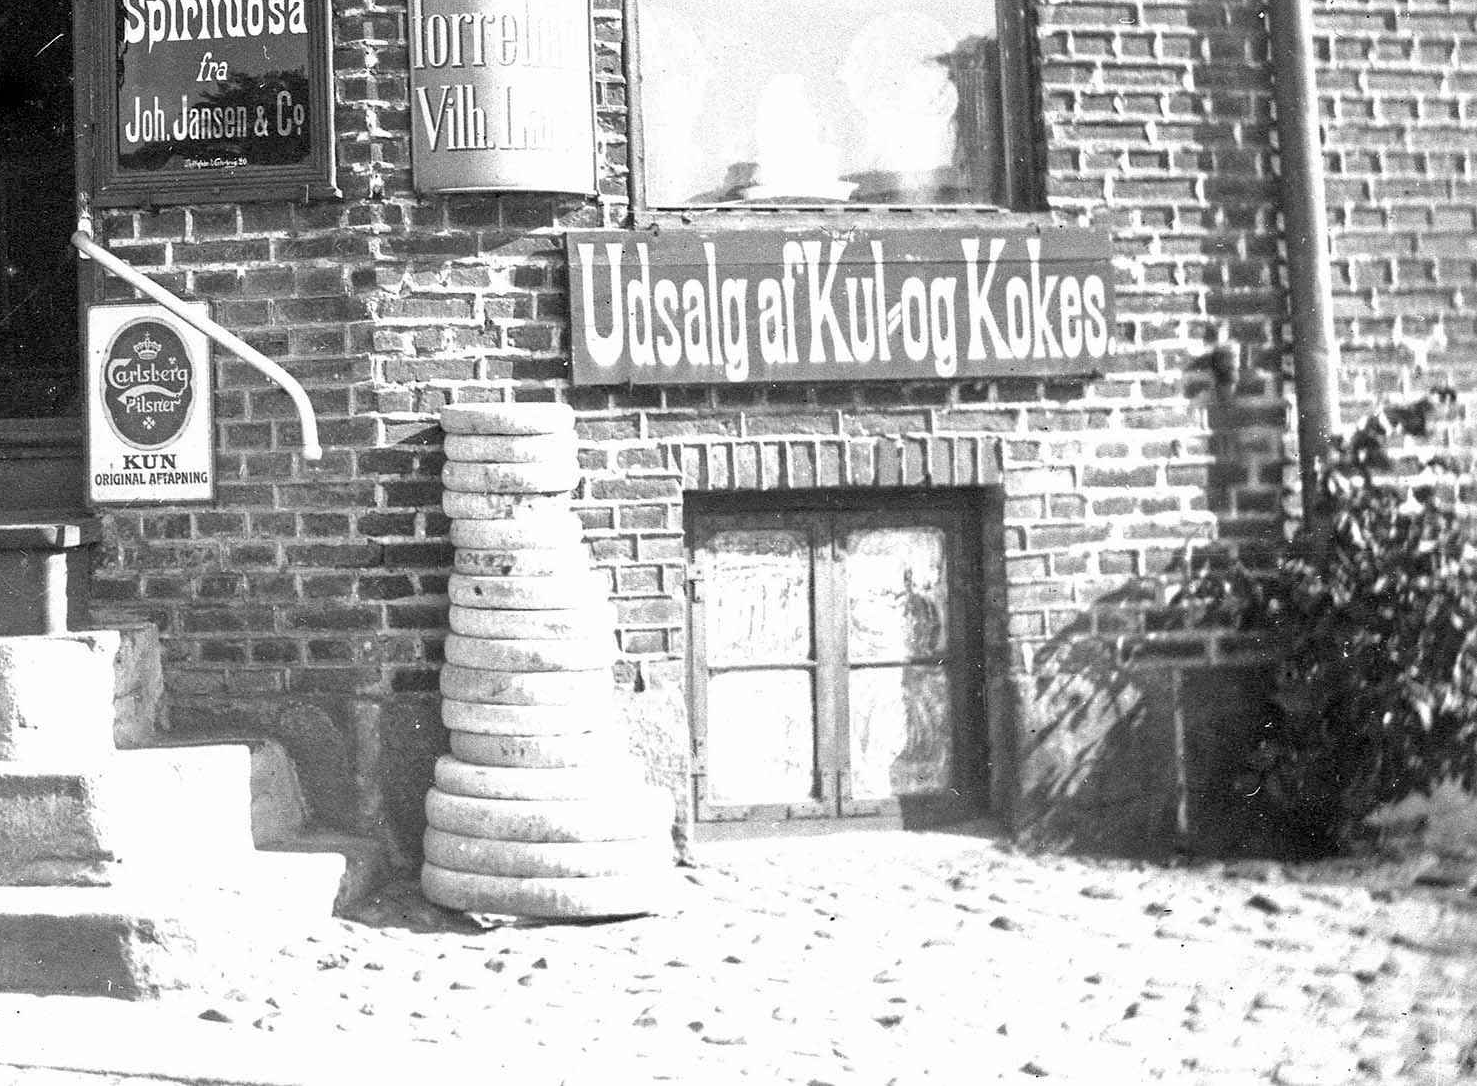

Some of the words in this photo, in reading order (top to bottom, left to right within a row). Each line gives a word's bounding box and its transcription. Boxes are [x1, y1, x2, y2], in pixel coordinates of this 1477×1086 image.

[196, 51, 228, 82] fra
[125, 95, 171, 142] Joh.
[173, 95, 247, 142] Jansen
[254, 104, 269, 137] &
[415, 83, 495, 152] Vilh.
[578, 241, 748, 382] Udsalg
[757, 240, 804, 365] af
[901, 275, 957, 379] og
[960, 238, 1117, 360] Kokes.
[107, 358, 188, 390] Carlsberg
[125, 395, 181, 413] Pilsner
[123, 454, 177, 470] KUN
[95, 472, 146, 486] ORIGINAL
[149, 471, 208, 485] AFTAPNING
